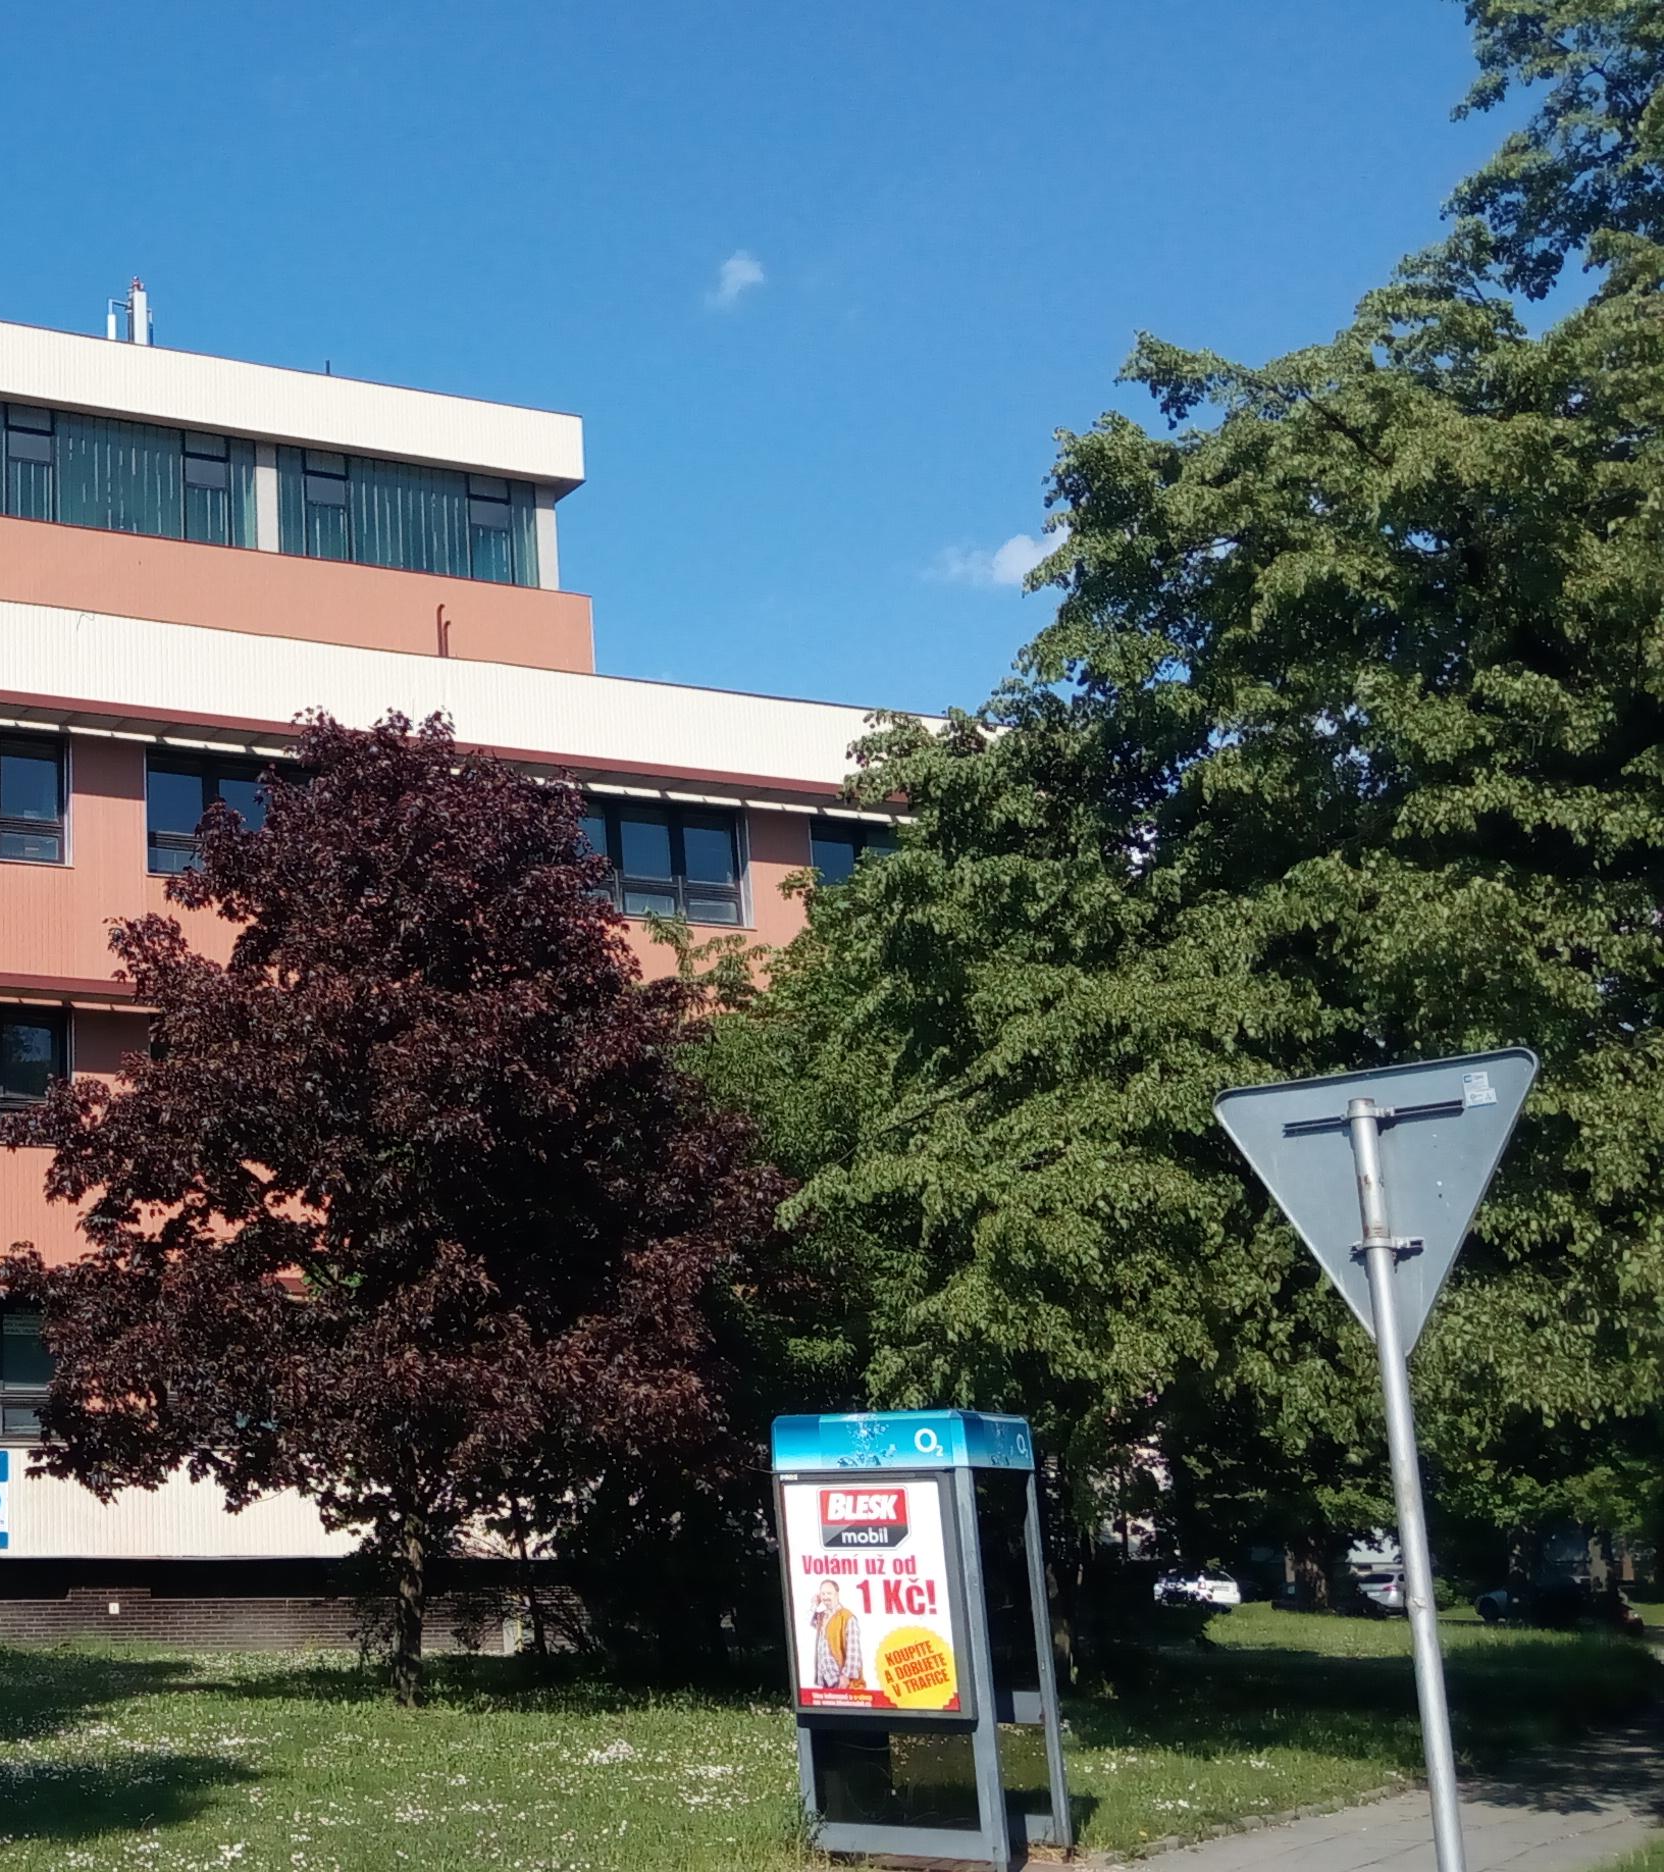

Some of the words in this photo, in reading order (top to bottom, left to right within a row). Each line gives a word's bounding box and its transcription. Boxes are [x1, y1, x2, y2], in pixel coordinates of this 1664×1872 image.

[827, 1493, 898, 1520] BLESK
[841, 1527, 889, 1544] mobil
[802, 1554, 859, 1575] Volání
[865, 1556, 886, 1575] už
[892, 1555, 916, 1575] od
[856, 1580, 872, 1613] 1
[884, 1578, 937, 1615] Kč!
[884, 1669, 894, 1684] A
[895, 1653, 947, 1680] DOBIJETE
[892, 1683, 902, 1697] V
[903, 1668, 950, 1694] TRAFICE
